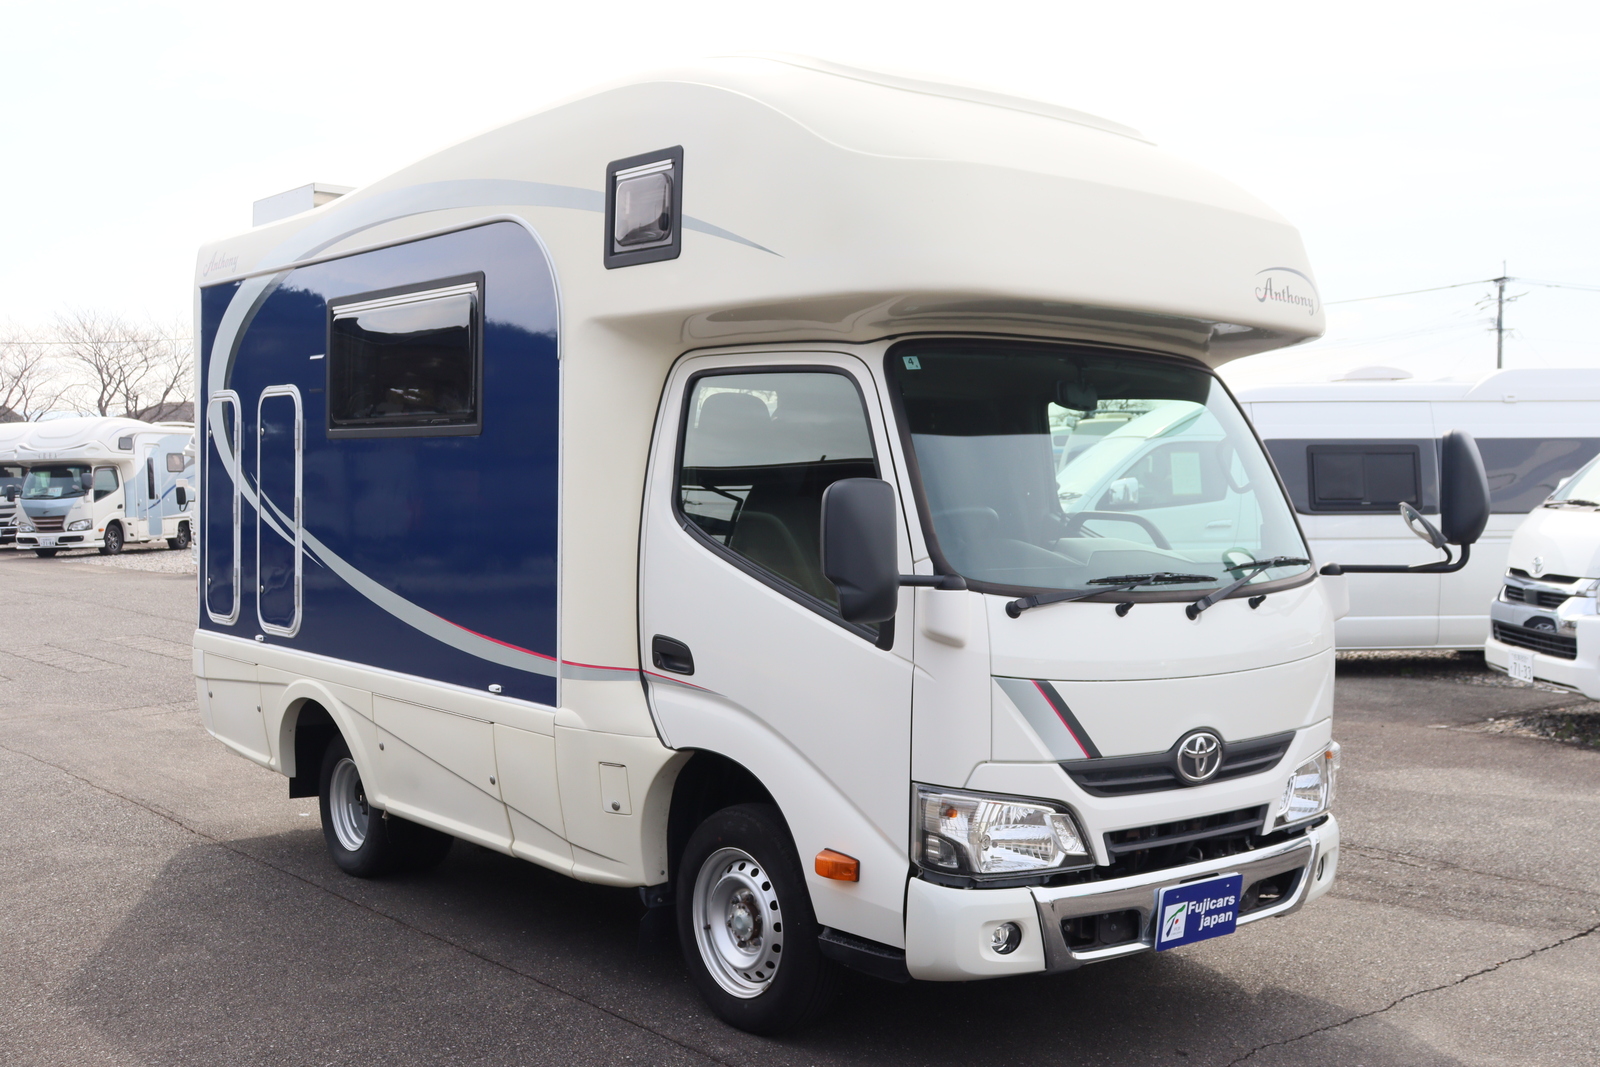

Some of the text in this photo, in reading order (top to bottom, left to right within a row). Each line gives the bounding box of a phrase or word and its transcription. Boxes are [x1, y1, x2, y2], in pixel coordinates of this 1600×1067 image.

[203, 250, 239, 277] Anthony
[1255, 277, 1314, 316] Anthony
[908, 357, 914, 366] 4
[1188, 895, 1235, 915] Fujicars
[1198, 911, 1233, 931] japan
